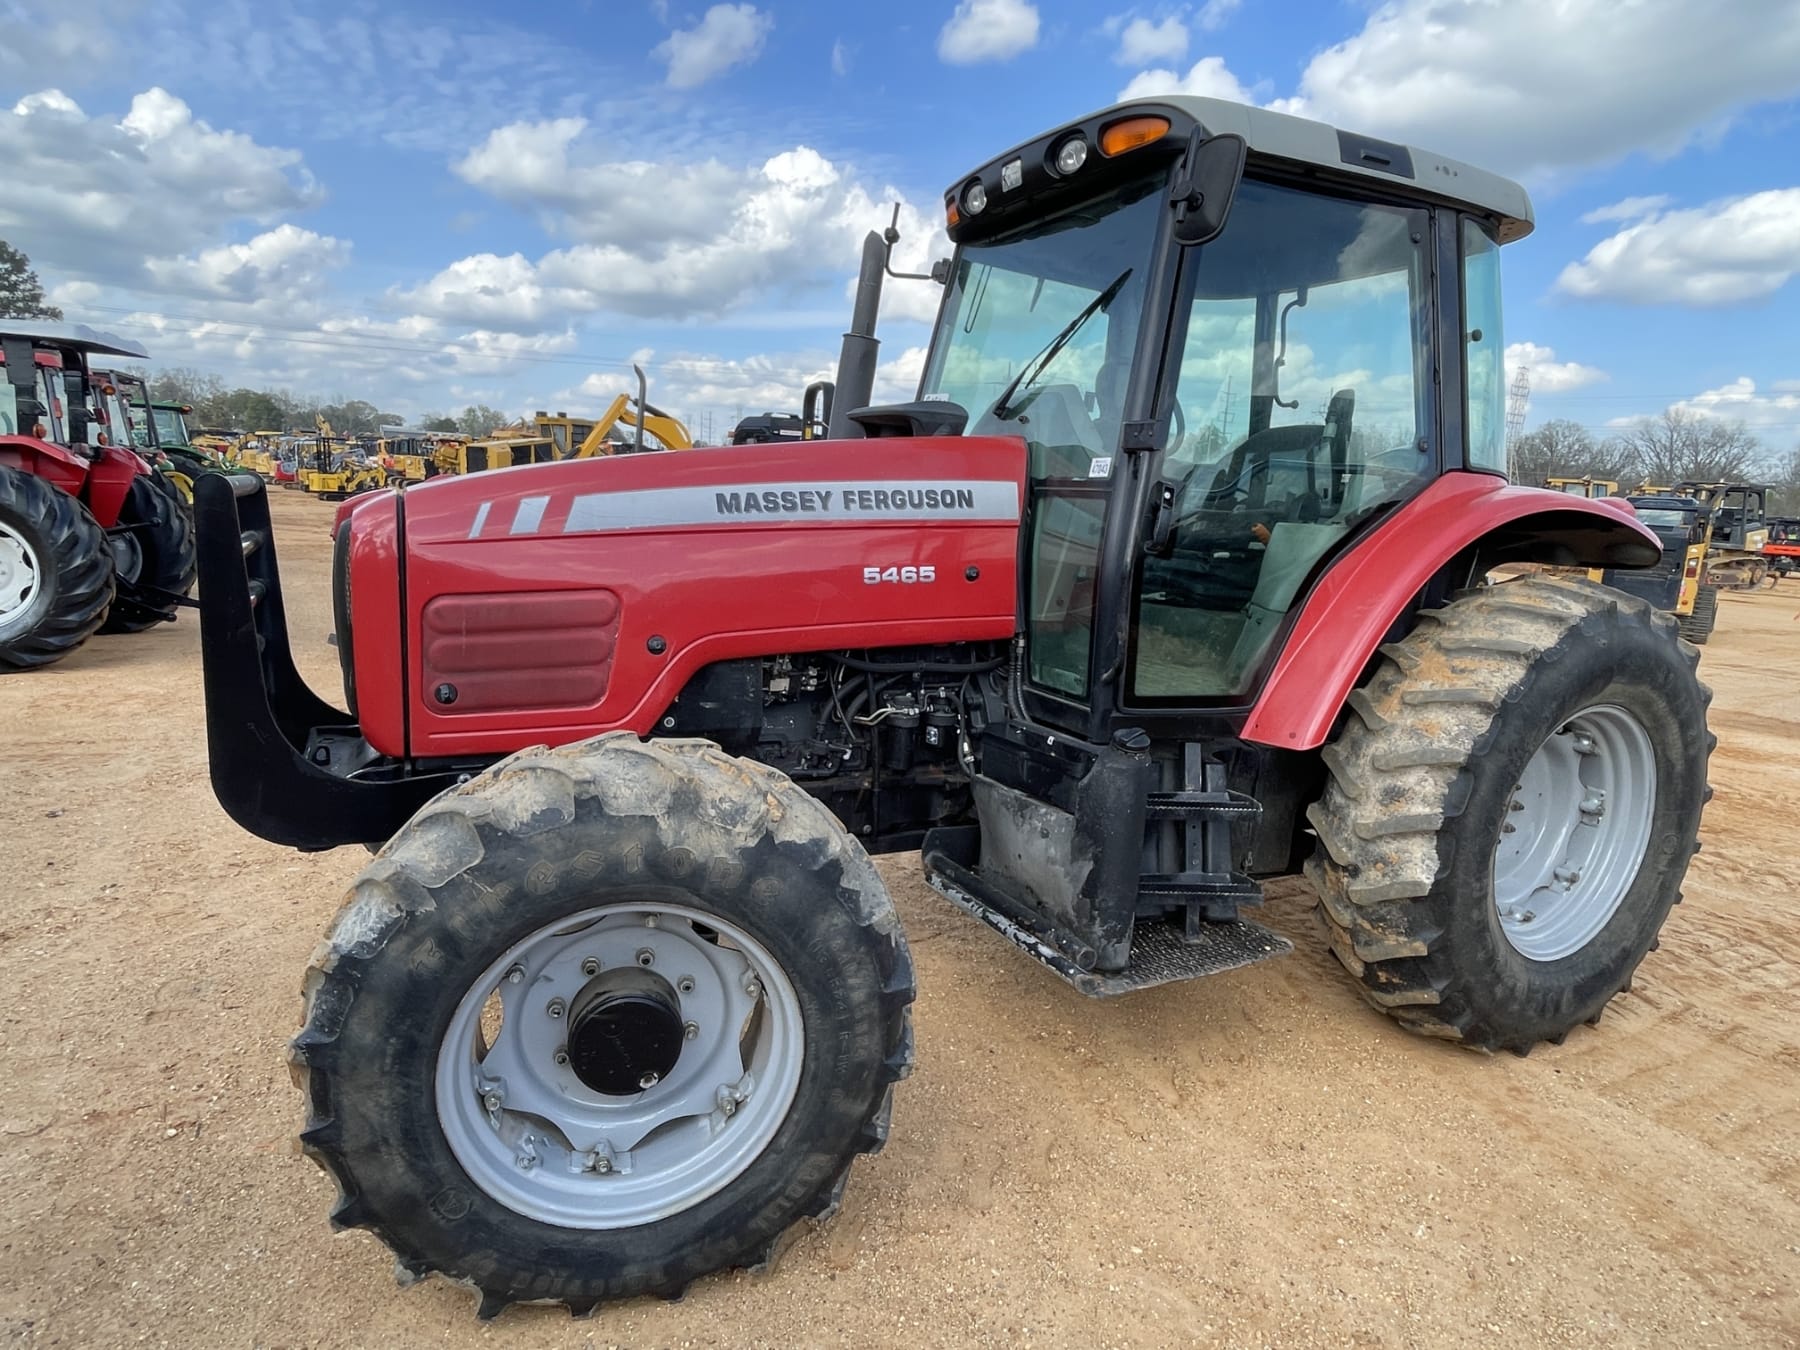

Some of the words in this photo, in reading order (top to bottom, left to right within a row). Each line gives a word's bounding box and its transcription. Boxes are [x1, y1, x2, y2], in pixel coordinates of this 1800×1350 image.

[716, 490, 832, 514] MASSEY
[842, 488, 974, 510] FERGUSON
[863, 566, 935, 585] 5465
